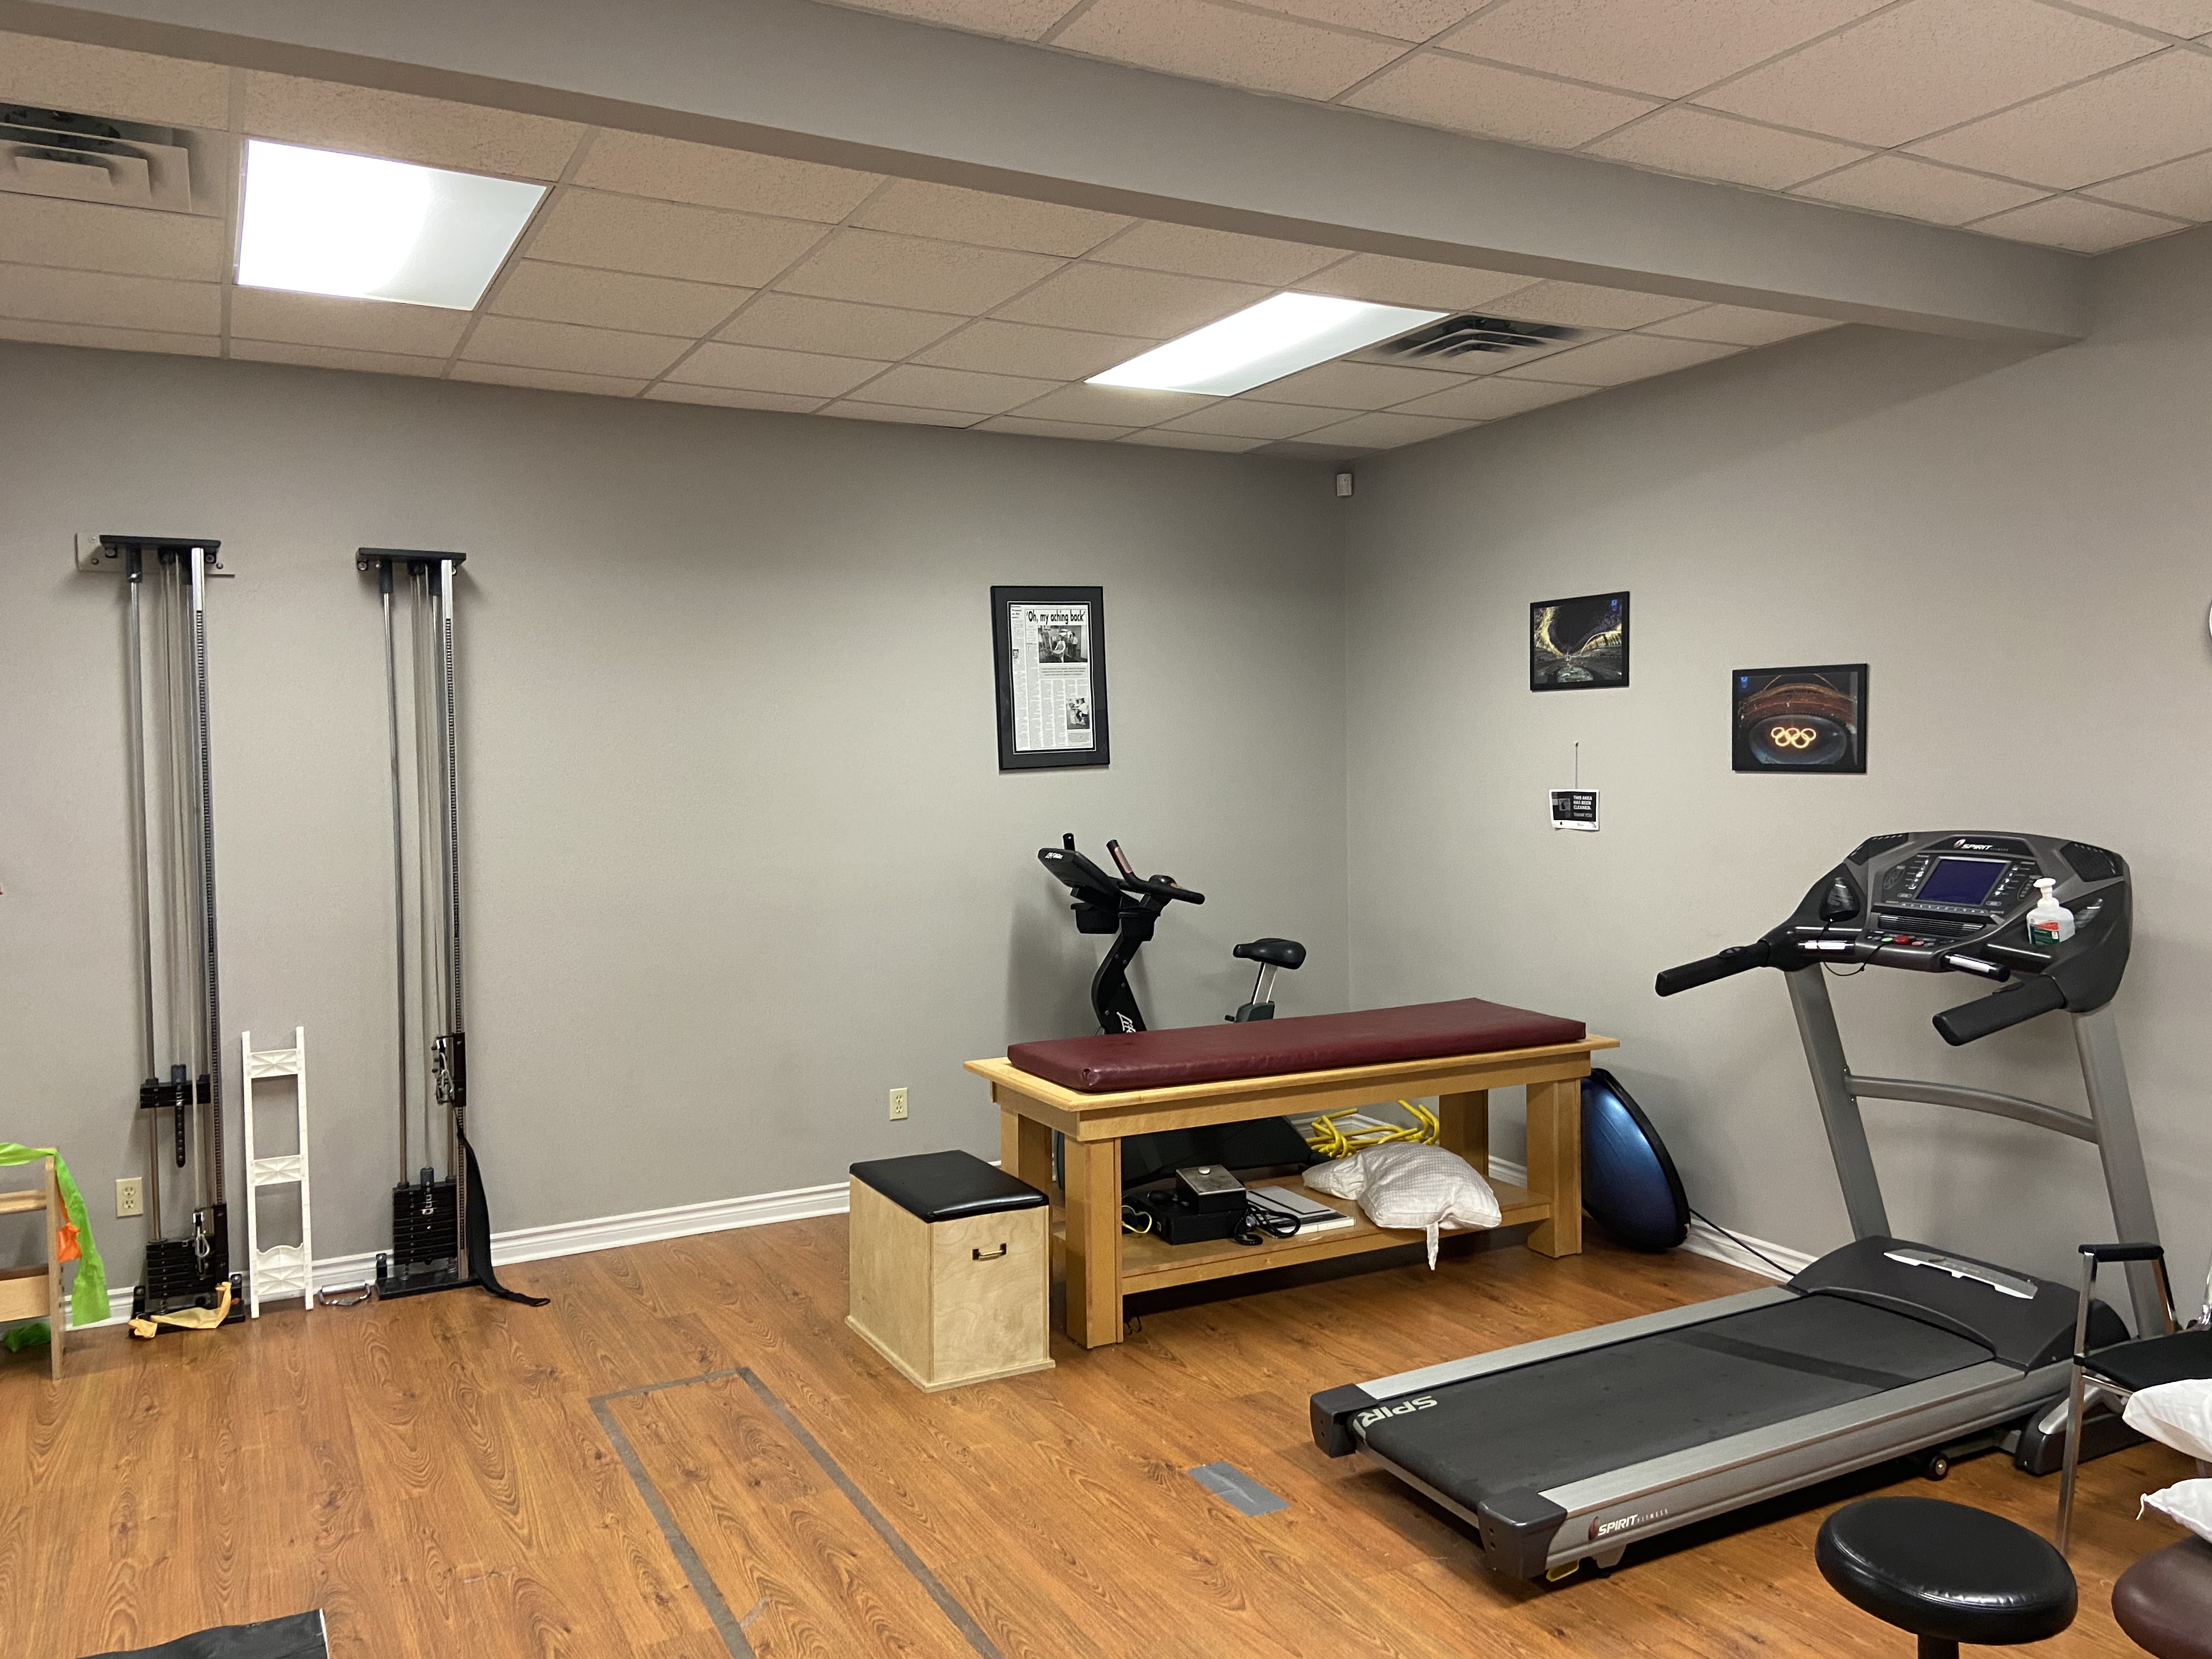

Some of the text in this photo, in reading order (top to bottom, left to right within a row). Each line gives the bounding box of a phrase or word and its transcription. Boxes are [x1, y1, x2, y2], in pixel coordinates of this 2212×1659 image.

[1040, 614, 1048, 625] my
[1051, 610, 1069, 624] aching
[1598, 1514, 1638, 1536] SPIRIT
